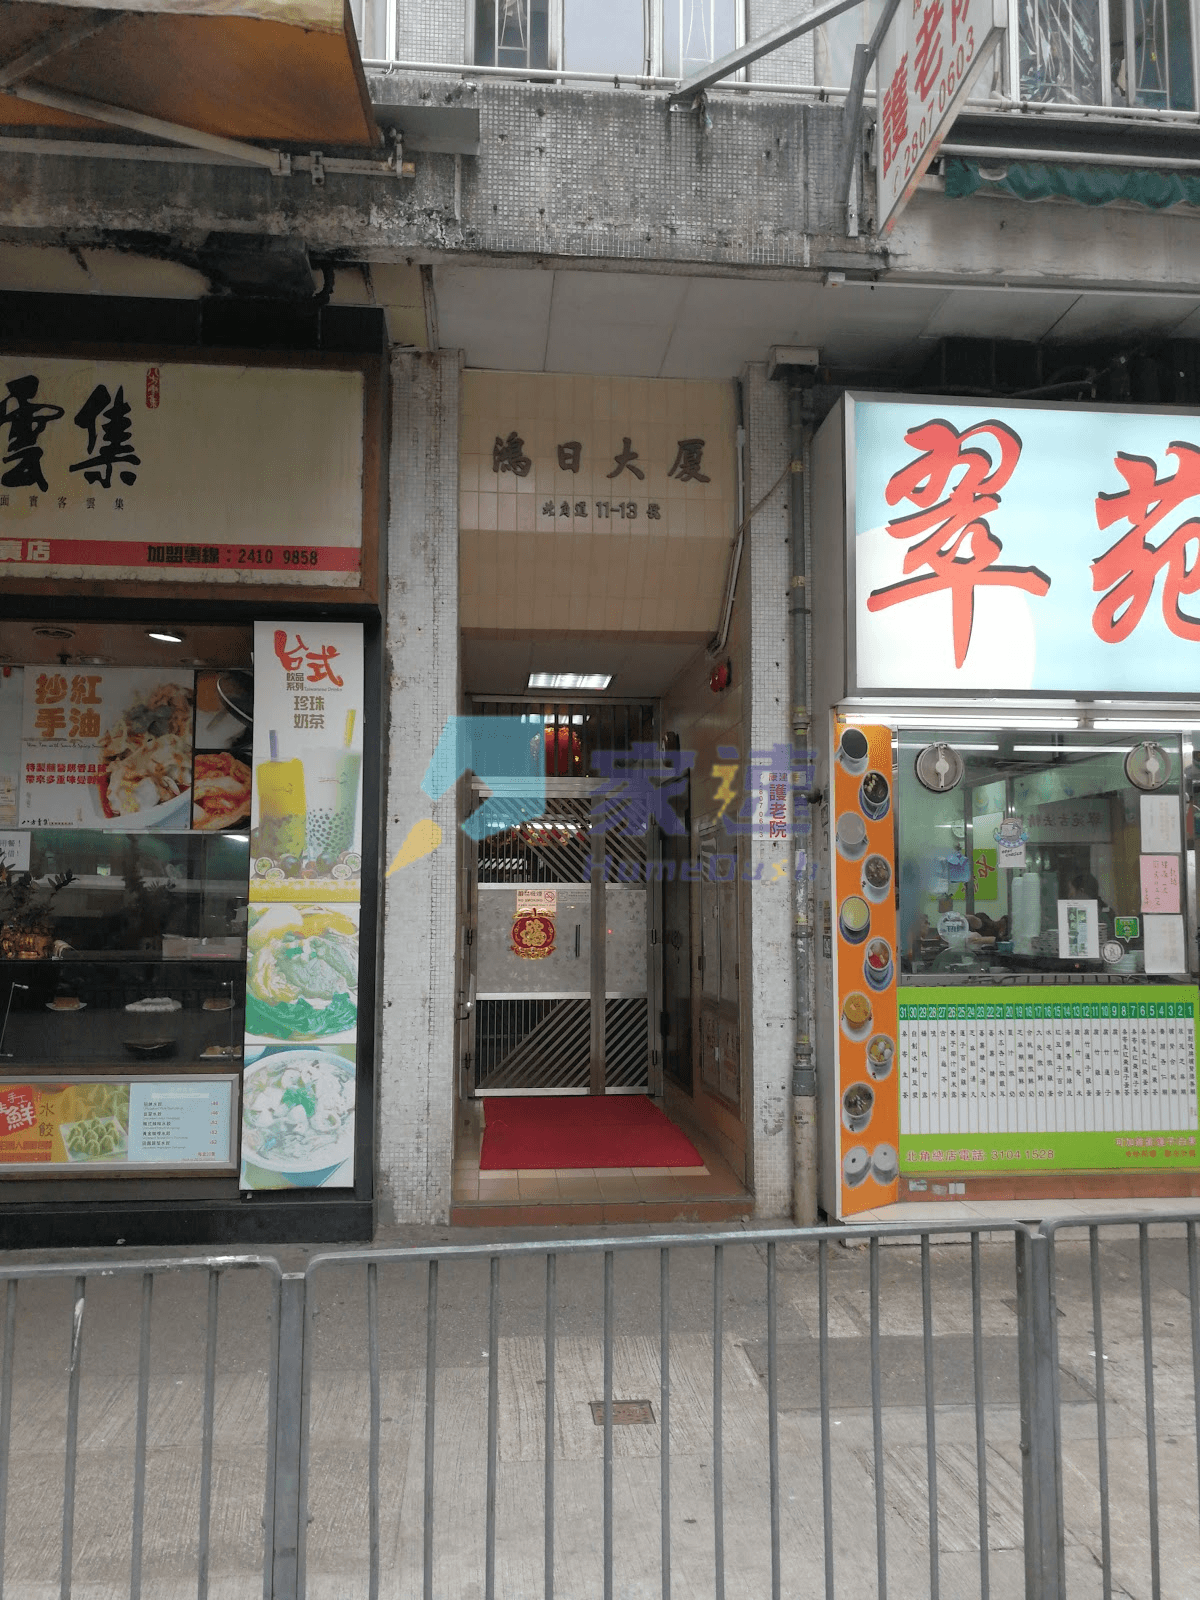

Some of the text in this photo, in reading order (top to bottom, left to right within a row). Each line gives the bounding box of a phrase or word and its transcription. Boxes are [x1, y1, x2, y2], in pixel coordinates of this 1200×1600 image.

[904, 26, 975, 178] 2807 0603
[542, 501, 589, 518] 北角道
[595, 501, 638, 519] 11-13
[866, 417, 1200, 670] 翠苑
[283, 549, 319, 565] 9858
[273, 629, 344, 688] 台式
[286, 682, 304, 691] 系列
[293, 695, 325, 711] 珍珠
[293, 713, 325, 730] 奶茶
[769, 783, 787, 839] 護老院
[899, 1006, 908, 1018] 31
[909, 1006, 917, 1018] 30
[918, 1006, 927, 1018] 29
[937, 1006, 946, 1018] 27
[956, 1006, 965, 1018] 25
[966, 1006, 975, 1018] 24
[985, 1005, 994, 1017] 22
[995, 1005, 1003, 1017] 21
[1014, 1005, 1022, 1017] 19
[1033, 1005, 1041, 1017] 17
[1052, 1005, 1060, 1017] 15
[1061, 1005, 1070, 1017] 14
[1071, 1005, 1079, 1017] 13
[1080, 1005, 1089, 1017] 12
[1090, 1005, 1098, 1017] 11
[1110, 1005, 1116, 1017] 9
[1120, 1005, 1126, 1017] 8
[1129, 1005, 1135, 1017] 7
[1139, 1005, 1145, 1017] 6
[1148, 1005, 1154, 1017] 5
[1158, 1005, 1164, 1017] 4
[1167, 1005, 1173, 1017] 3
[1177, 1005, 1183, 1017] 2
[1187, 1005, 1192, 1017] 1
[7, 1091, 28, 1104] 手工
[38, 1103, 55, 1137] 水餃
[990, 1150, 1022, 1161] 3104
[1024, 1148, 1055, 1160] 1528
